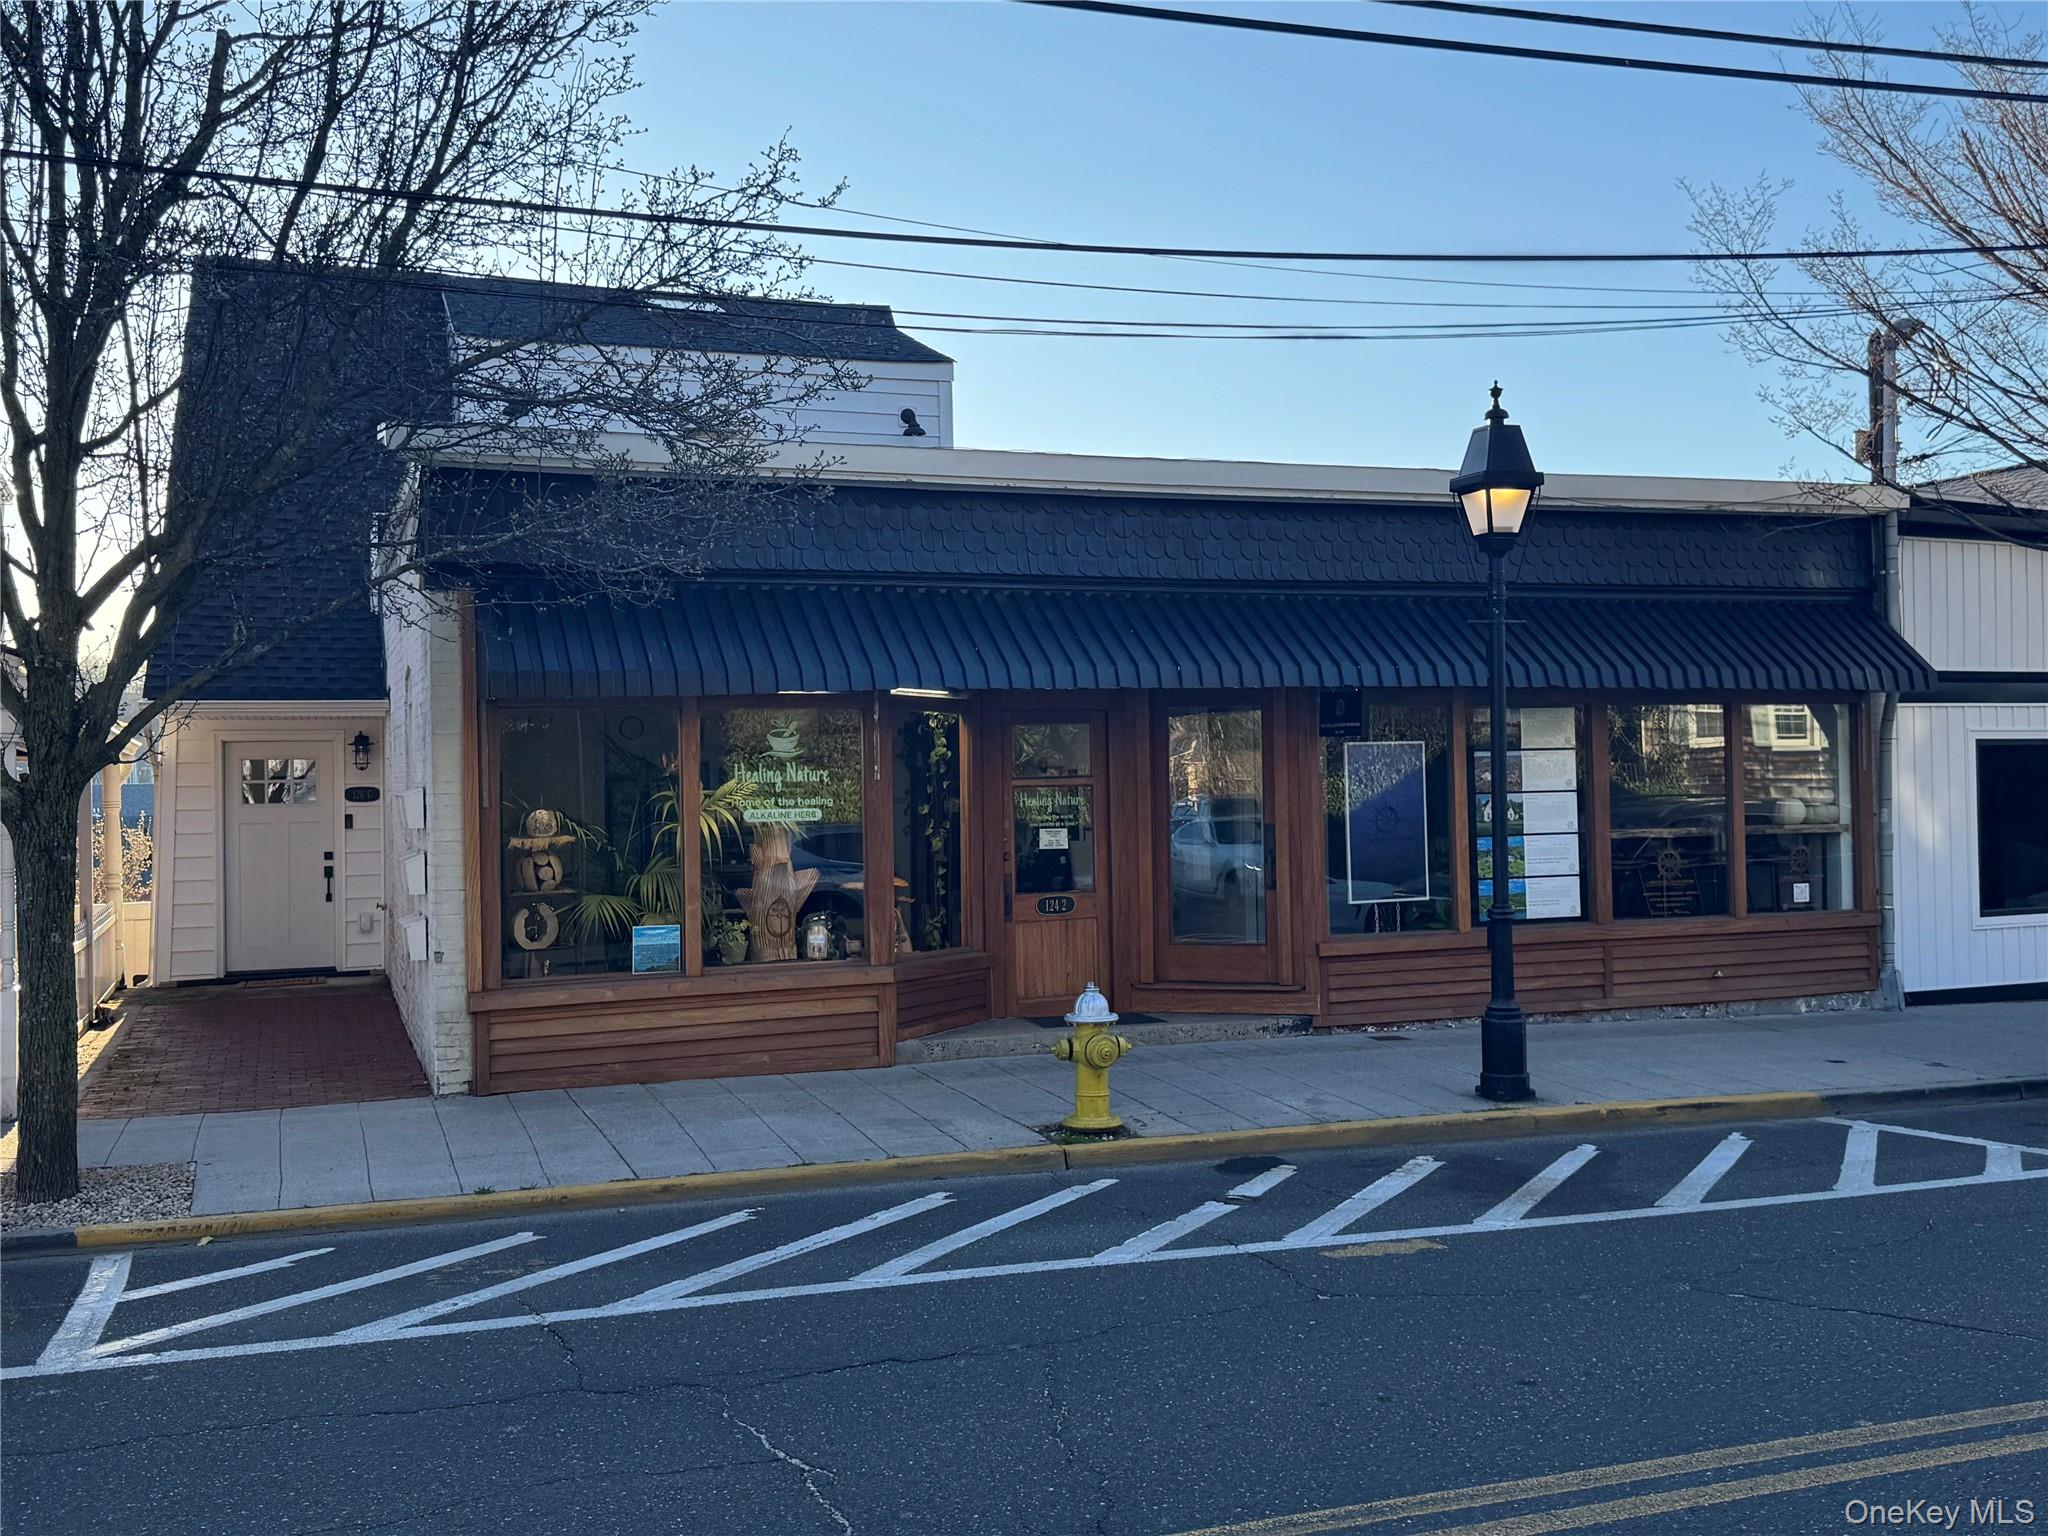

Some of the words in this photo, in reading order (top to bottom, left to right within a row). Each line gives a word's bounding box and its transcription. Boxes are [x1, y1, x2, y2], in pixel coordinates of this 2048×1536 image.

[734, 762, 782, 792] Healing
[786, 762, 831, 785] Nature
[764, 797, 776, 809] of
[778, 797, 795, 806] the
[797, 796, 834, 807] healing
[1019, 791, 1053, 813] Healing
[749, 811, 793, 820] ALKALINE
